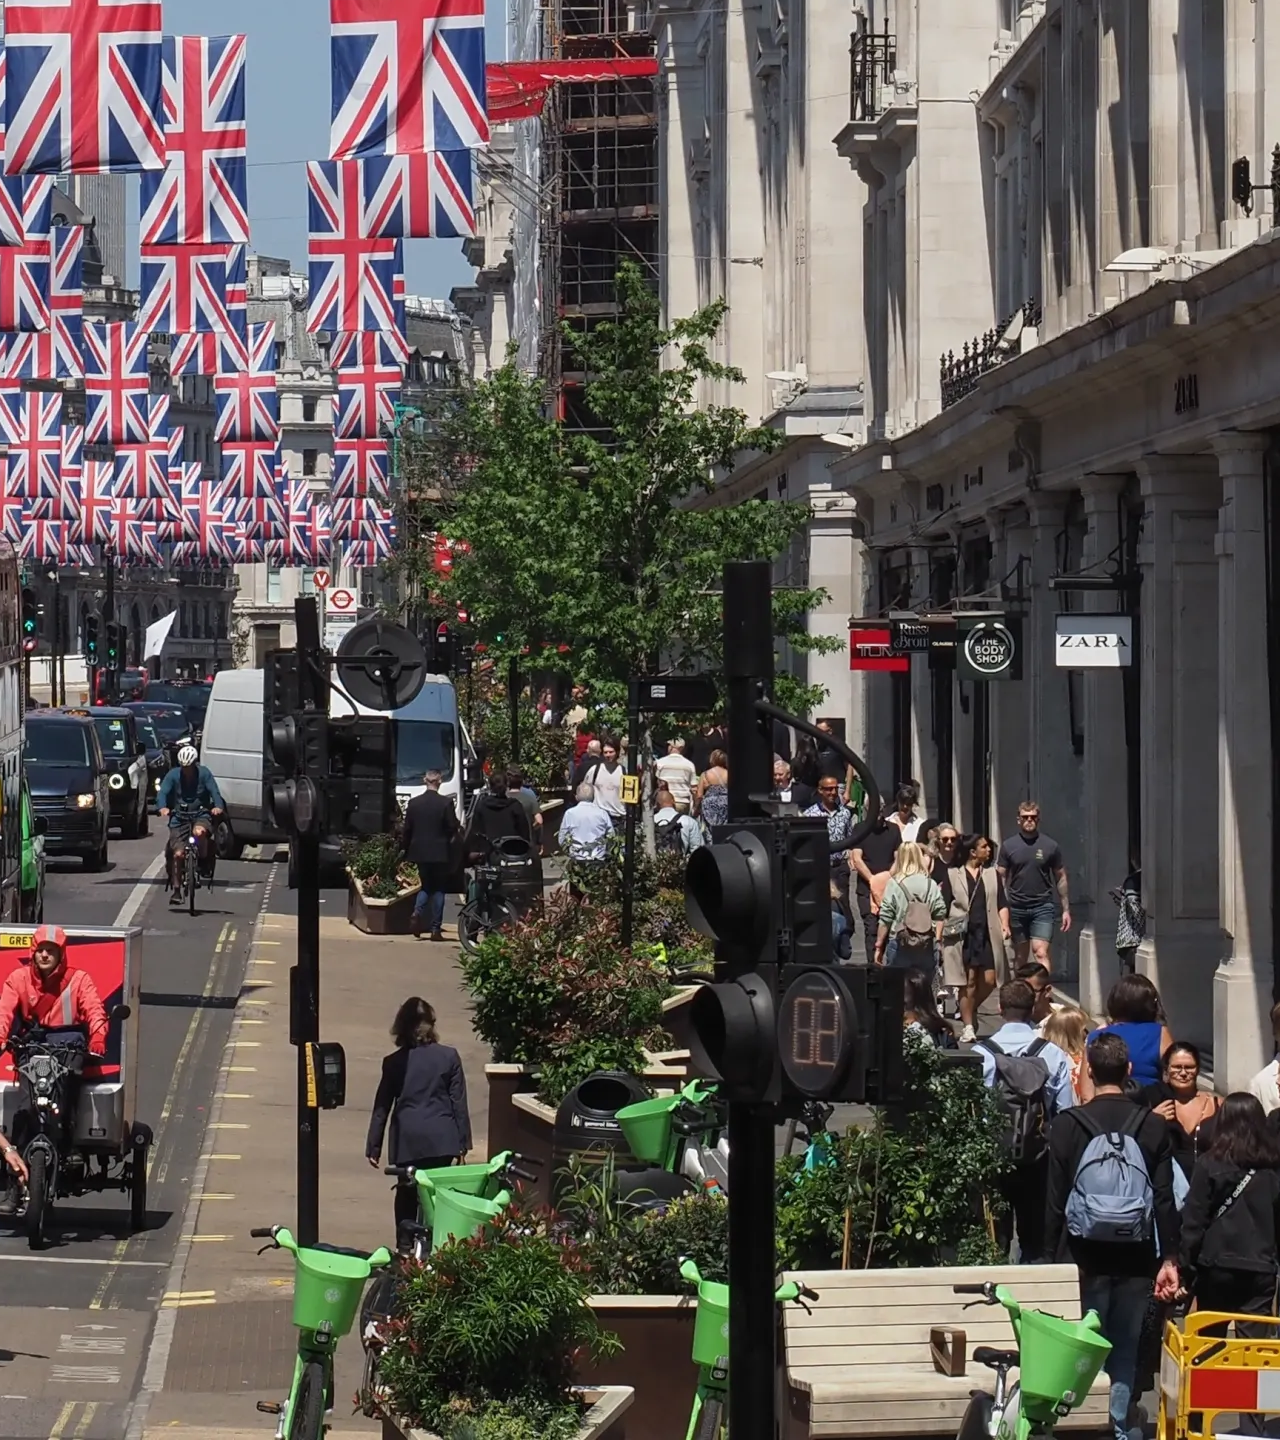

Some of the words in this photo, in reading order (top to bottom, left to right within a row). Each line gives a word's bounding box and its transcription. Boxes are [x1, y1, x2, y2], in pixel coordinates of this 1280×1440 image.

[316, 573, 327, 586] V
[982, 638, 998, 646] THE
[1060, 635, 1129, 648] ZARA
[975, 645, 1006, 655] BODY
[976, 654, 1004, 664] SHOP
